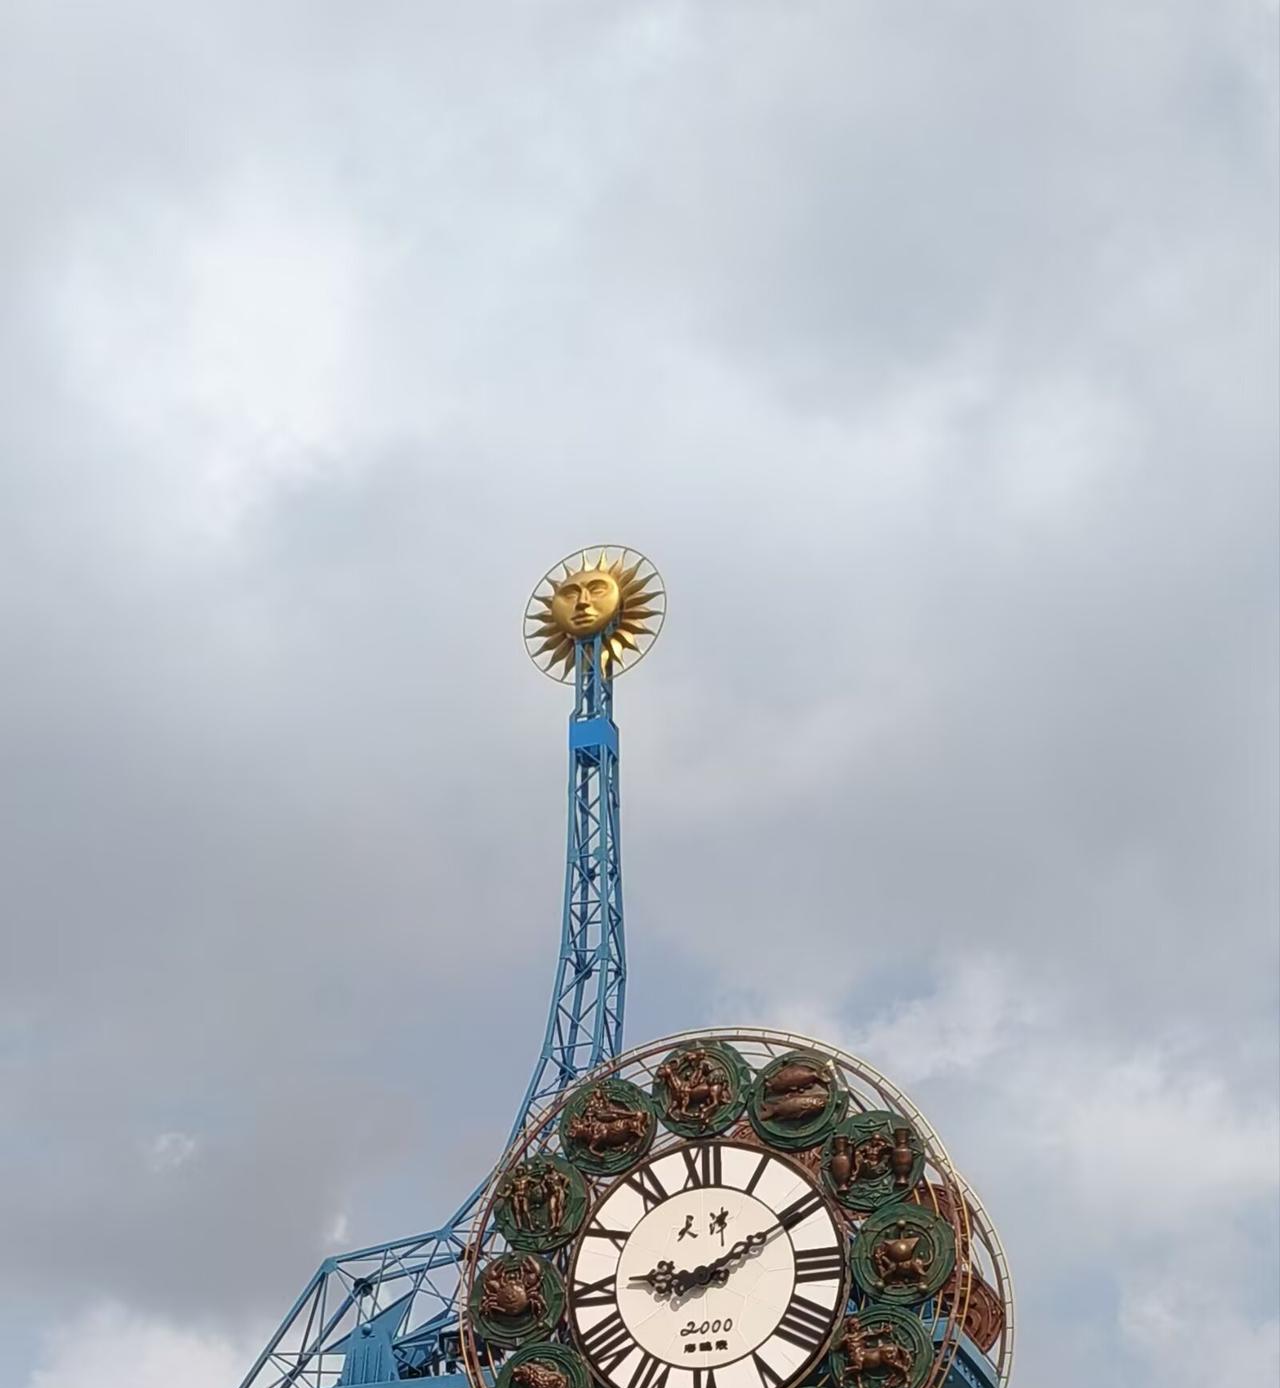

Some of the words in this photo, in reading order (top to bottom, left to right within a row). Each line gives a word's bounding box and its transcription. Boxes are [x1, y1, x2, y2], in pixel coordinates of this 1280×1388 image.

[680, 1146, 722, 1188] XII
[623, 1164, 669, 1213] XI
[677, 1206, 729, 1247] 天津
[777, 1190, 826, 1232] II
[585, 1219, 631, 1251] X
[794, 1246, 841, 1283] III
[573, 1274, 617, 1307] IX
[580, 1310, 637, 1376] VIII
[680, 1318, 733, 1336] 2000
[773, 1294, 834, 1352] IIII
